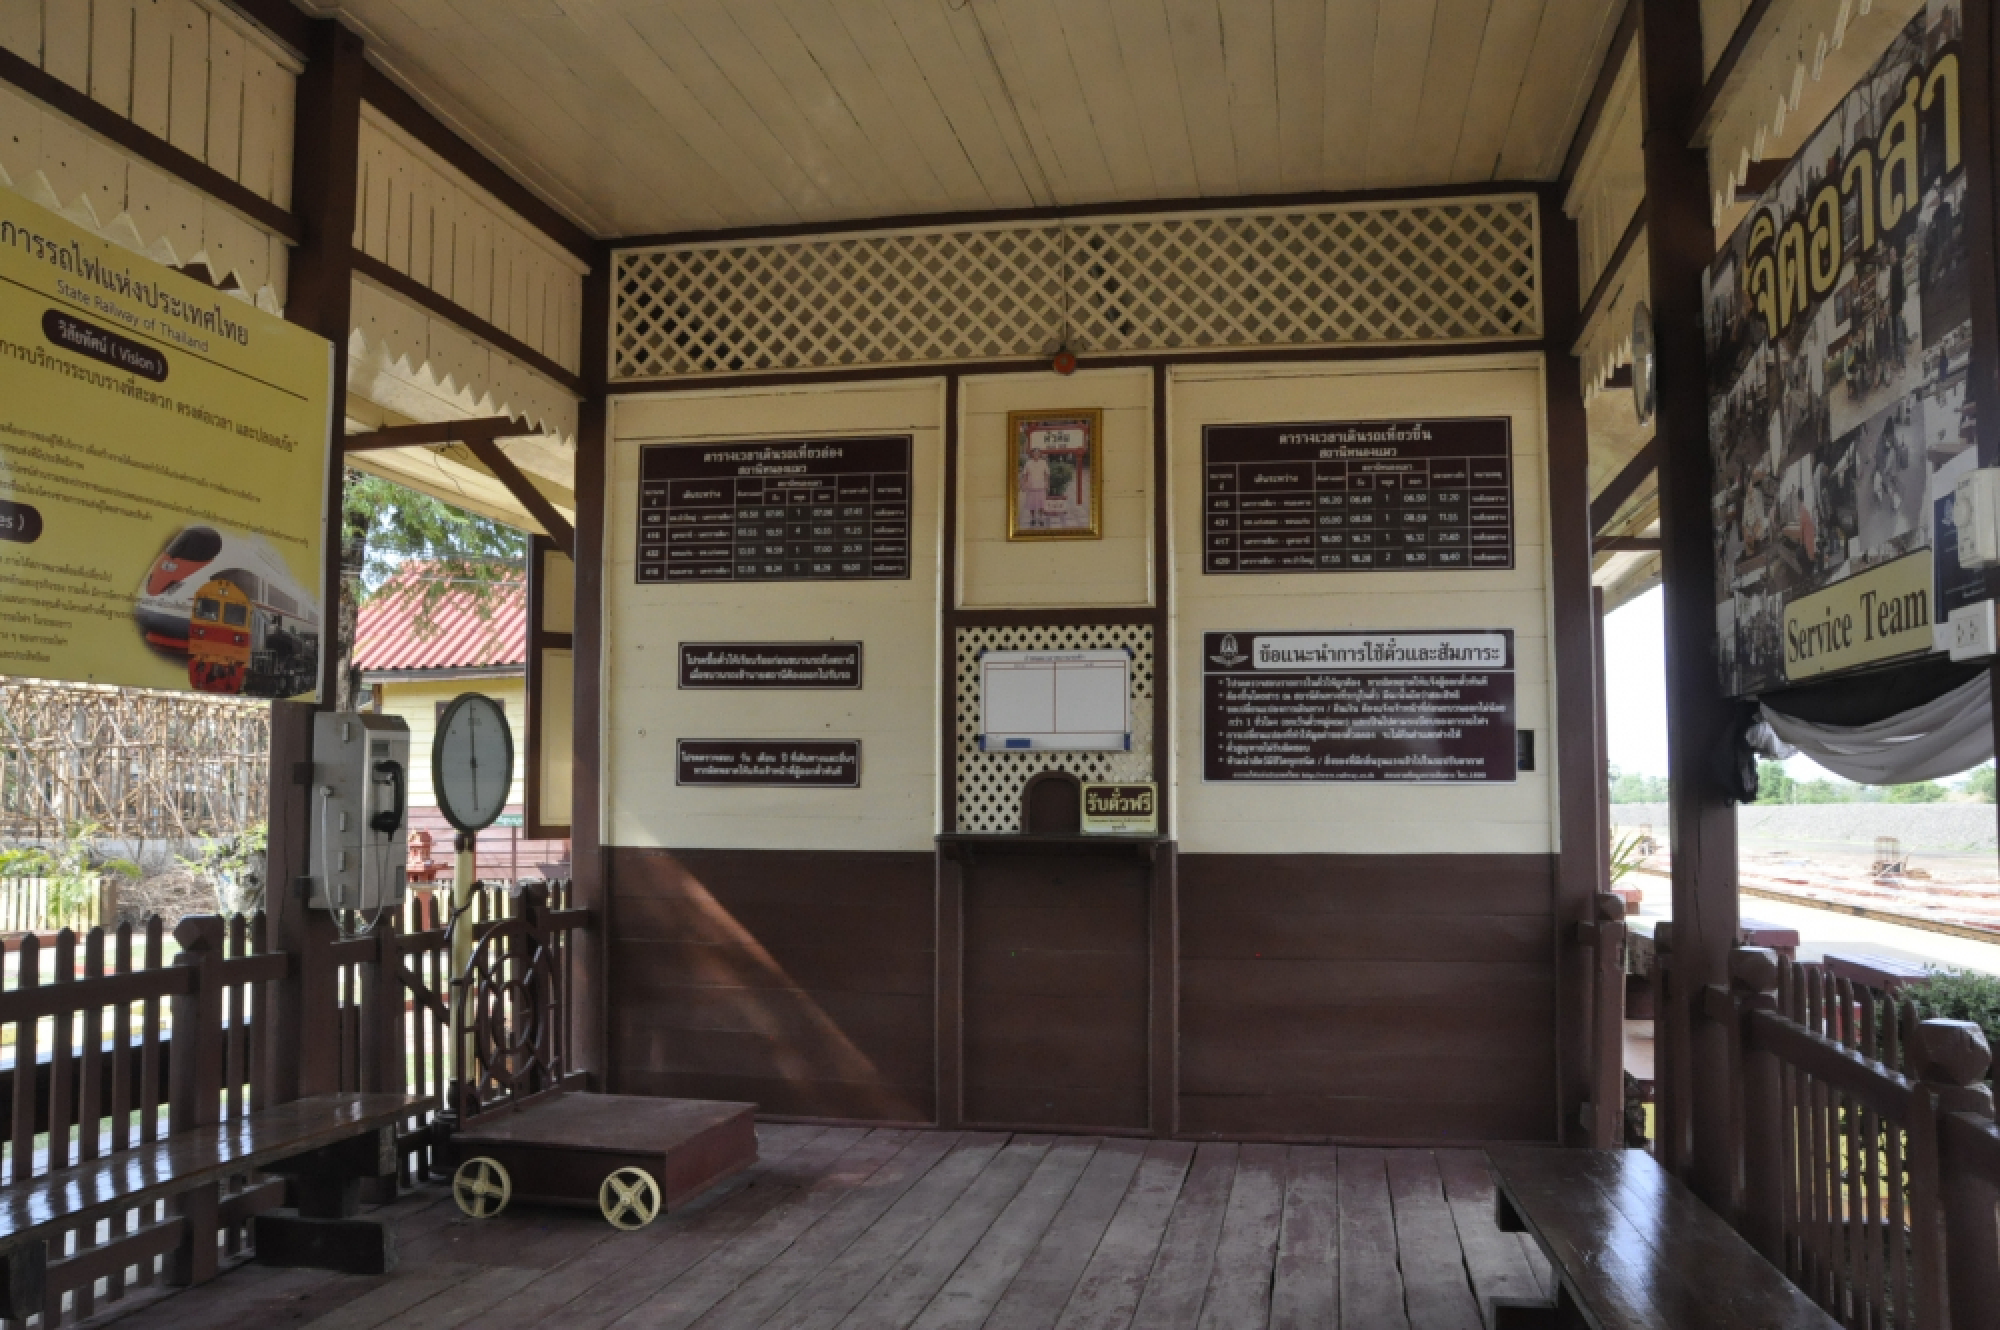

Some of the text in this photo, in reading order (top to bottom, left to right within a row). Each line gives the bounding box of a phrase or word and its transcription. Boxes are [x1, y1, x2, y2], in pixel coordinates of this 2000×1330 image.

[1746, 48, 1963, 343] จิตอาสา
[2, 220, 249, 346] การรถไฟแห่งประเทศไทย
[57, 279, 208, 353] State Railway of Thailand
[119, 345, 154, 371] Vision
[1259, 638, 1501, 663] ข้อแนะนำการใช้ตั๋วและสัมภาระ
[1787, 588, 1929, 662] Service Team
[1087, 787, 1151, 812] รับตั๋วฟรี
